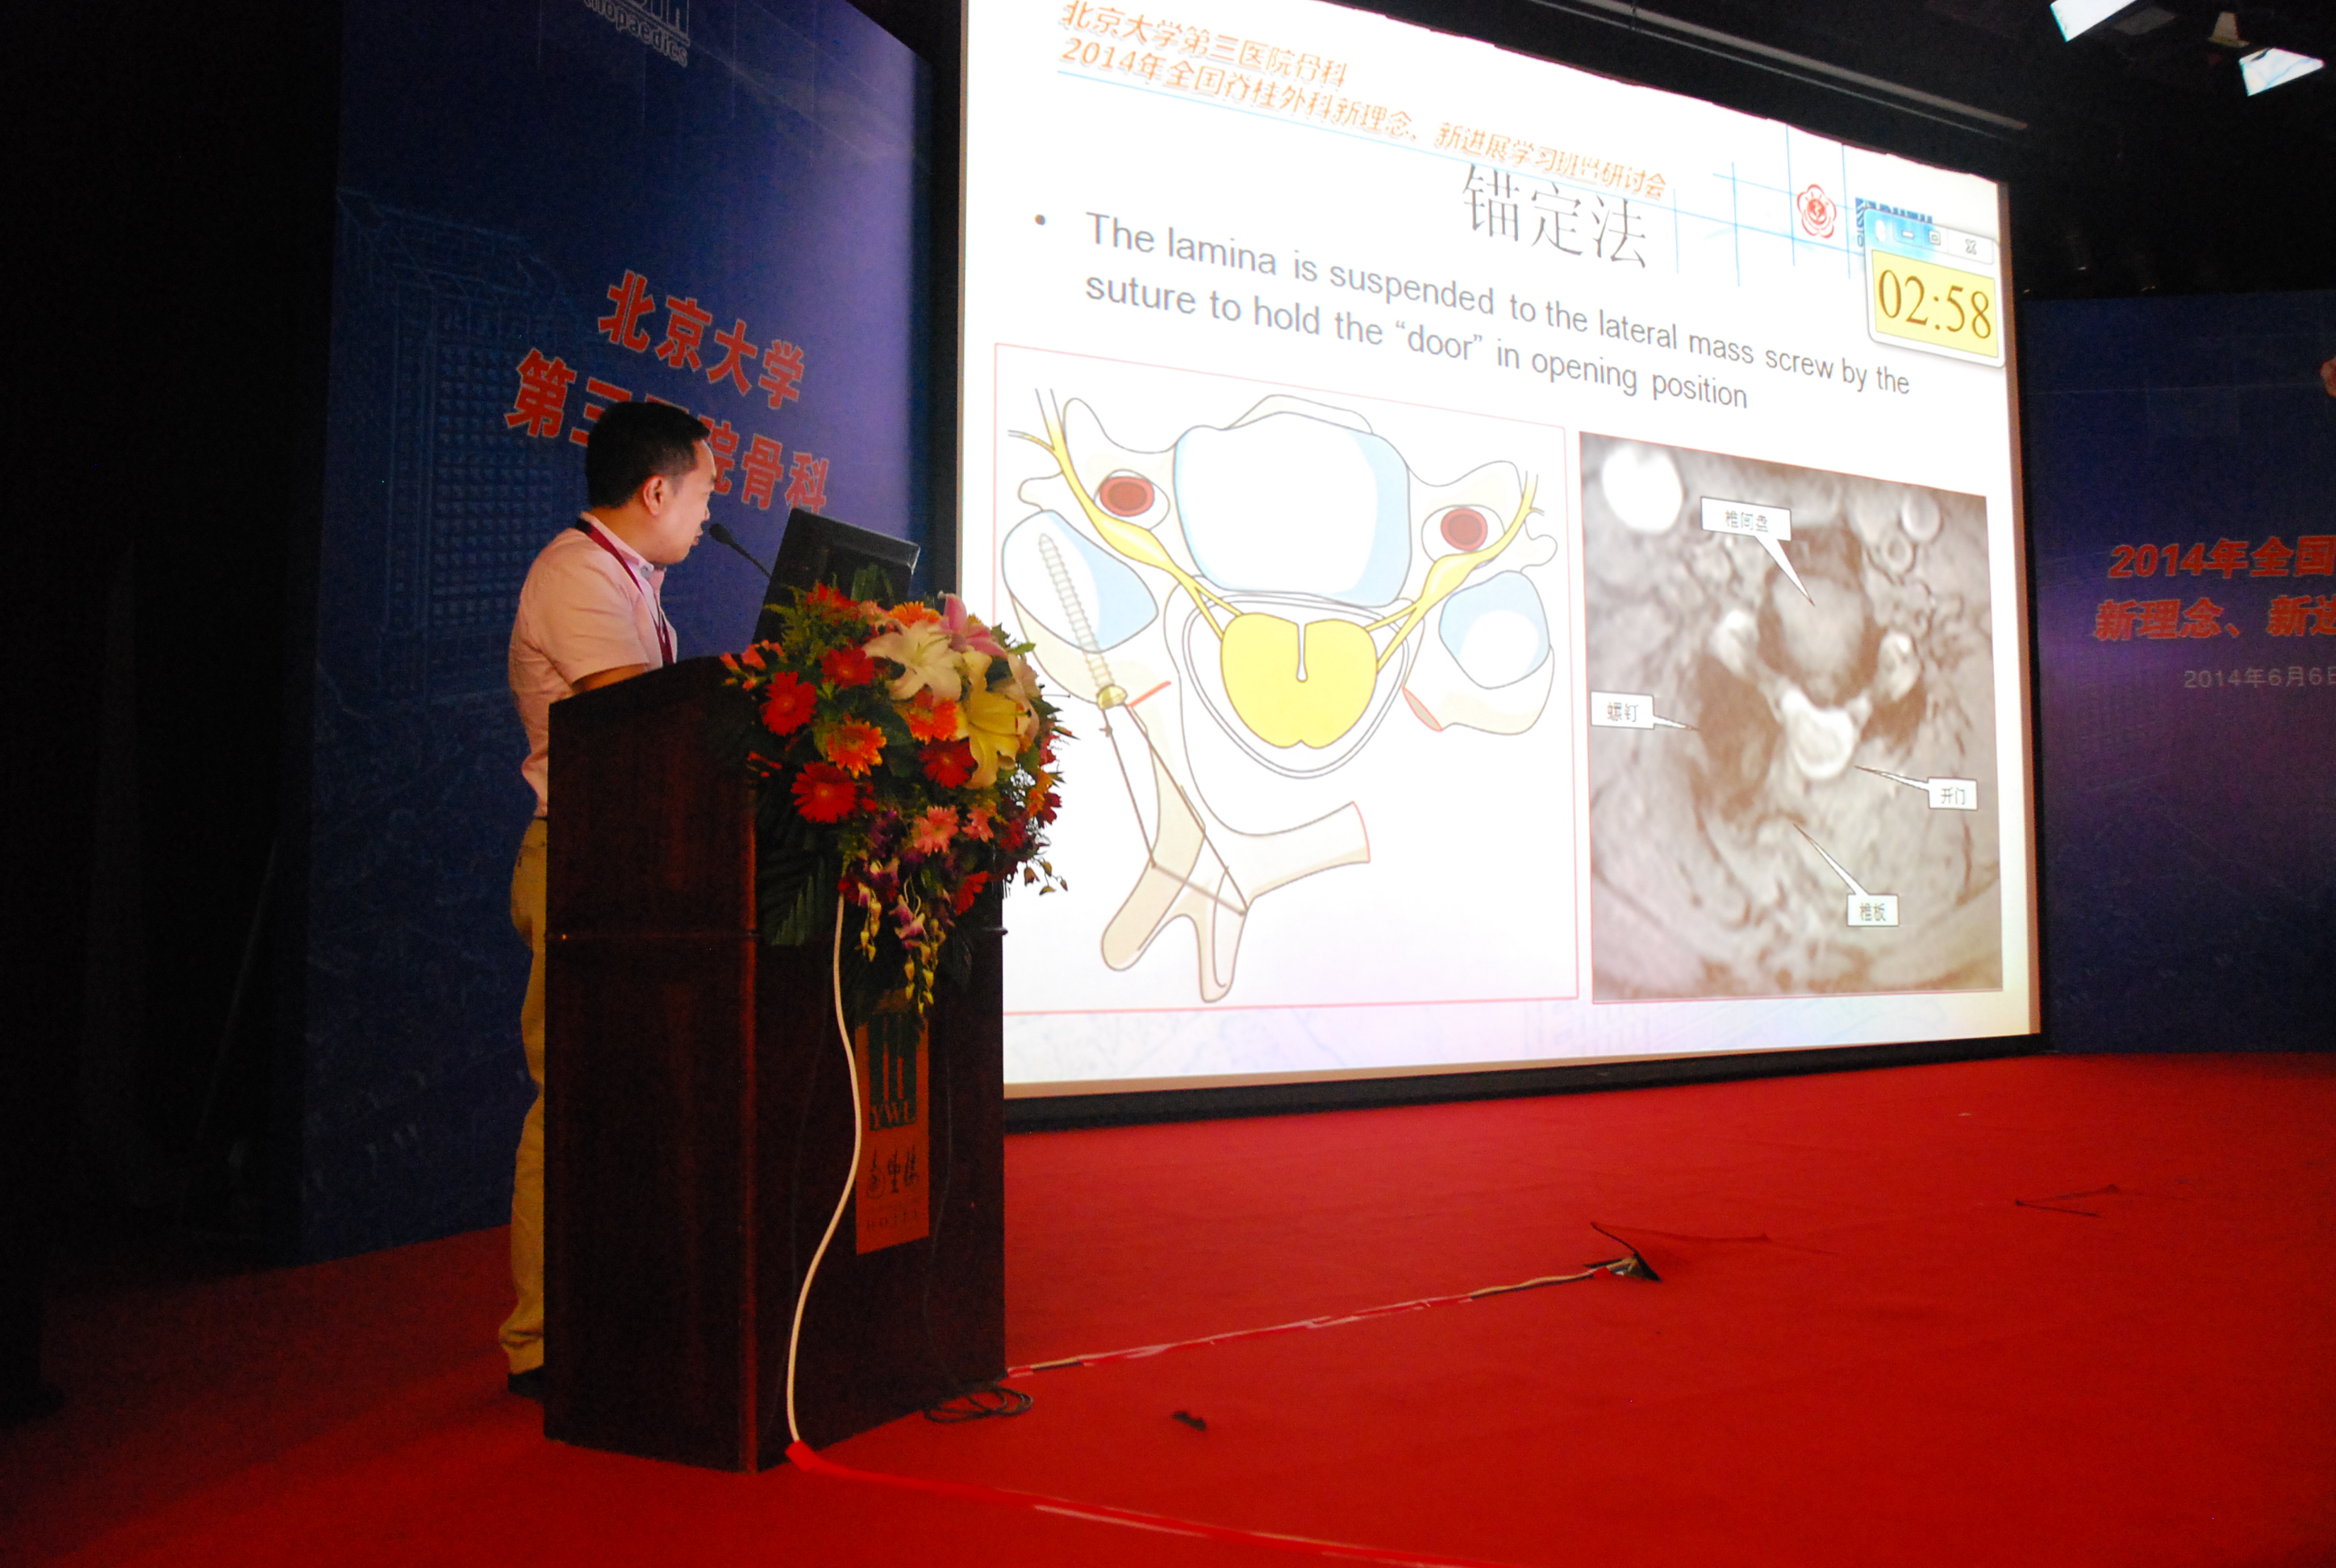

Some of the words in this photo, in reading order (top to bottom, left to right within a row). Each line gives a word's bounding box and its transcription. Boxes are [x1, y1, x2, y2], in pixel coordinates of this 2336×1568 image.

[584, 0, 688, 67] opaedics
[1058, 0, 1347, 87] 北京大学第三医院骨科
[1462, 163, 1646, 268] 锚定法
[598, 269, 804, 410] 北京大学
[1086, 211, 1154, 252] The
[1168, 227, 1276, 275] lamina
[1294, 249, 1317, 281] is
[1329, 265, 1493, 315] suspended
[1509, 294, 1536, 322] to
[1546, 301, 1587, 332] the
[1600, 309, 1677, 349] lateral
[1689, 335, 1754, 364] mass
[1766, 349, 1833, 379] screw
[1842, 357, 1867, 392] by
[1876, 365, 1909, 394] the
[1086, 277, 1195, 314] suture
[1210, 290, 1241, 321] to
[1254, 295, 1319, 335] hold
[1335, 311, 1383, 344] the
[1496, 338, 1520, 369] in
[1532, 353, 1637, 397] opening
[1653, 374, 1747, 408] position
[1878, 269, 1992, 340] 02:58
[504, 348, 828, 513] 第三院骨科
[2108, 536, 2336, 578] 2014年全国
[1941, 786, 1966, 805] 开门
